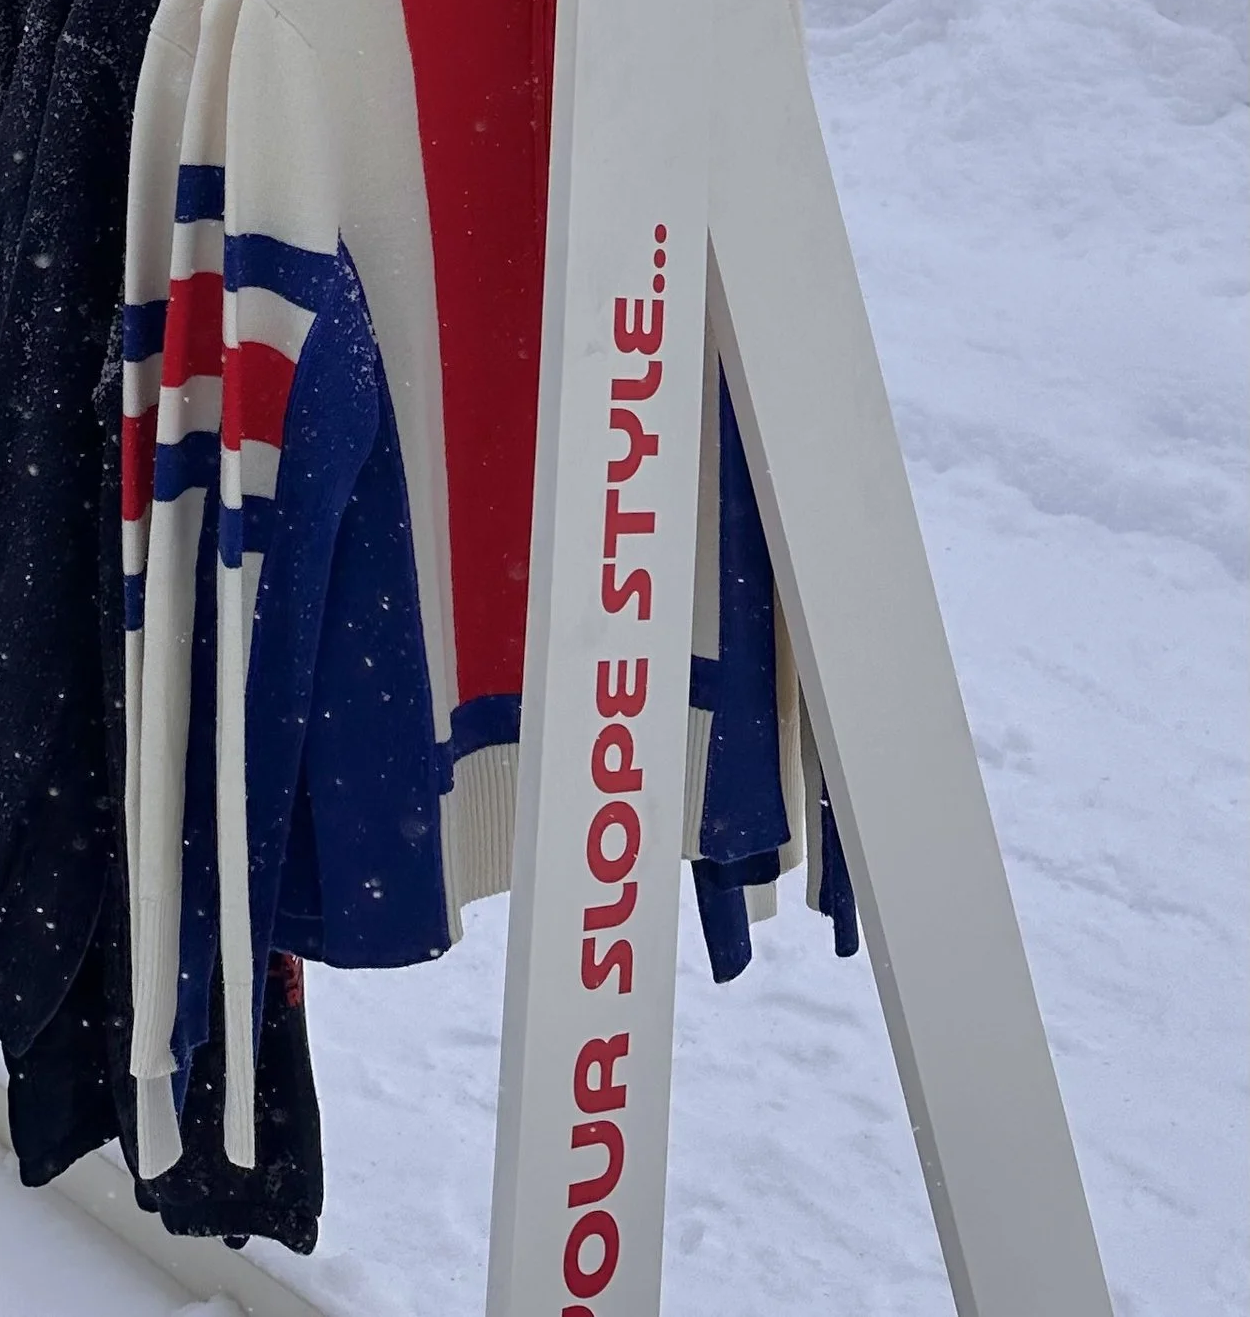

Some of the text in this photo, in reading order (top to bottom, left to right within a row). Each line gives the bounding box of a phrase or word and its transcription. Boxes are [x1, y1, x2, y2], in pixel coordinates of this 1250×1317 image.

[561, 223, 667, 1317] OUR SLOPE STYLE...
